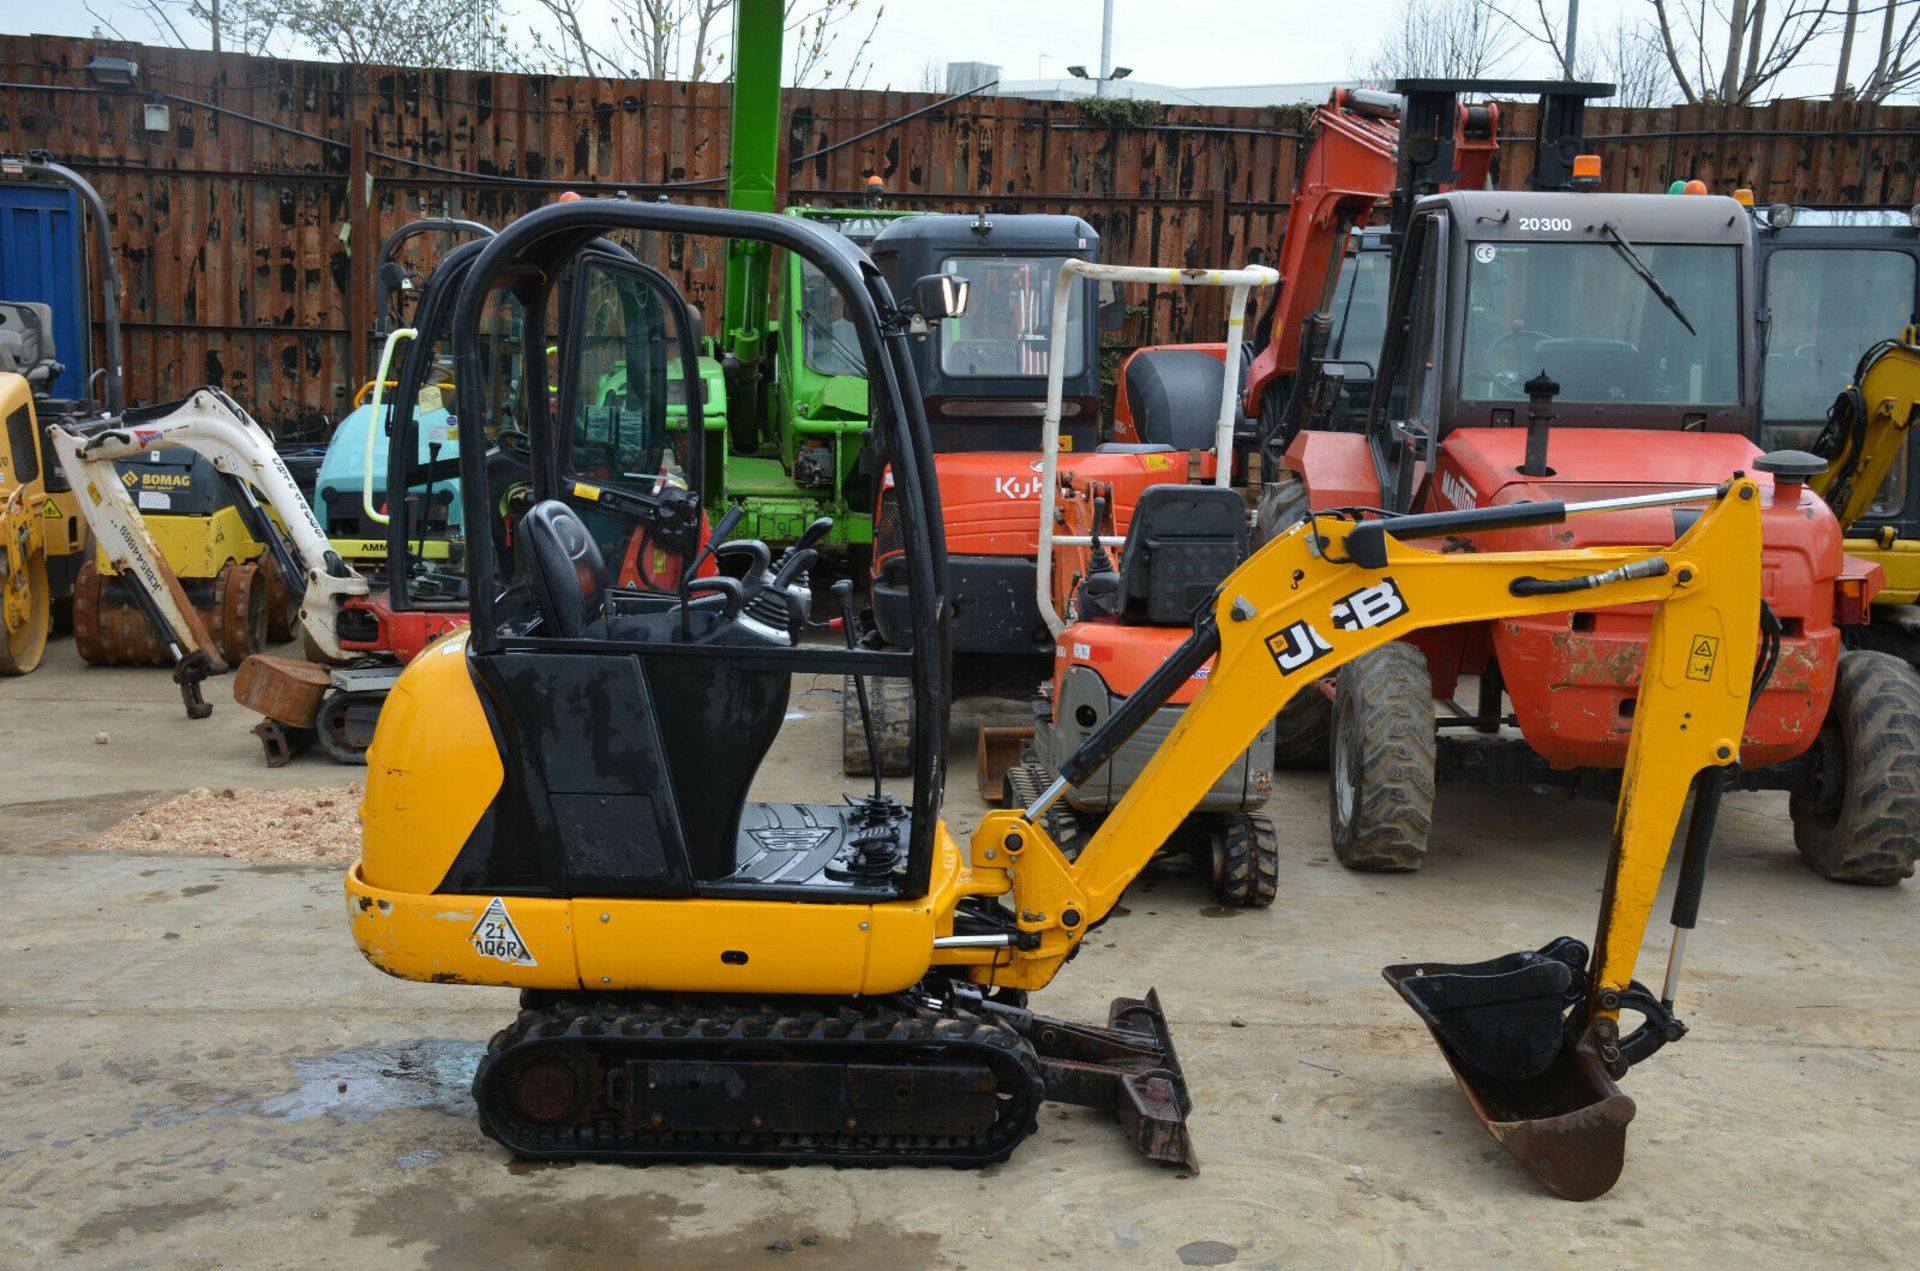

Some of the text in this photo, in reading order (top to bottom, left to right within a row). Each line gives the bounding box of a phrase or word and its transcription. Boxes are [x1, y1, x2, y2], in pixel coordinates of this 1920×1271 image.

[1519, 217, 1572, 232] 20300
[142, 473, 192, 487] BOMAG
[485, 922, 506, 940] 21
